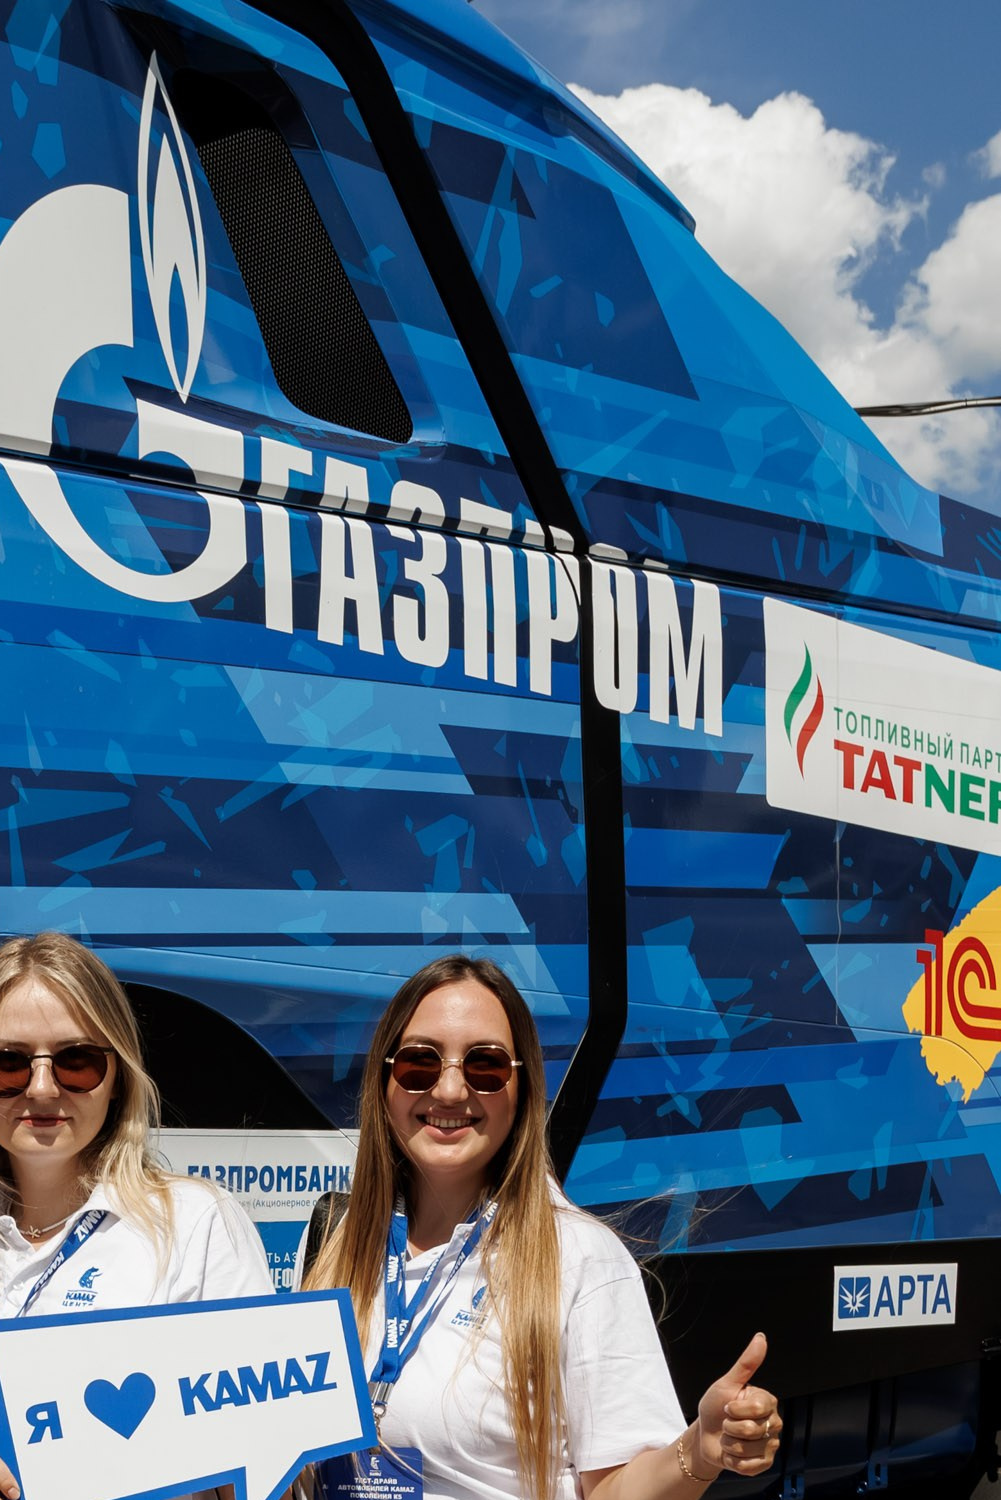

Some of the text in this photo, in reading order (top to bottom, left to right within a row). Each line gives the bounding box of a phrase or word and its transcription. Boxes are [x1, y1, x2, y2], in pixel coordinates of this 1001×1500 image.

[257, 434, 724, 739] ГАЗПРОМ
[833, 706, 953, 761] ТОПЛИВНЫЙ
[74, 1209, 106, 1242] AMAZ
[386, 1255, 399, 1283] KAMAZ
[873, 1273, 952, 1318] АРТА
[386, 1317, 398, 1349] KAMAZ
[25, 1351, 338, 1445] Я KAMAZ
